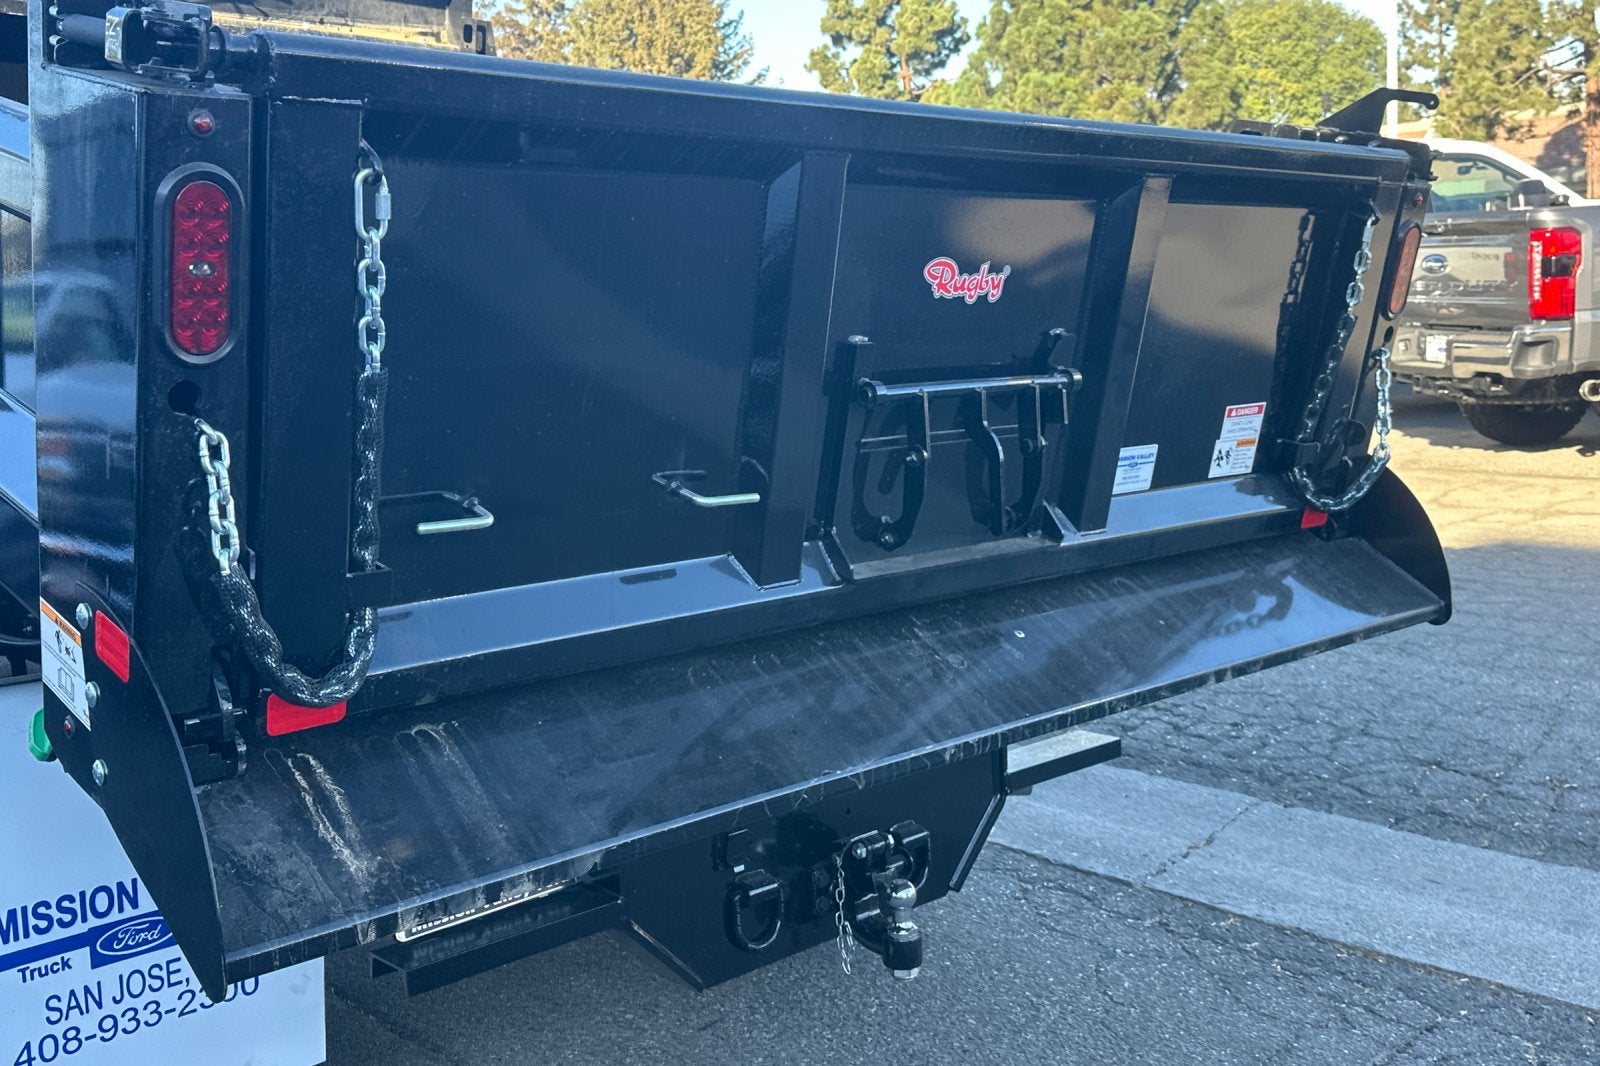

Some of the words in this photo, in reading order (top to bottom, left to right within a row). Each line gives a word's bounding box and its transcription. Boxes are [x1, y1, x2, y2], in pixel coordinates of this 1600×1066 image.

[924, 257, 1004, 304] Rugby
[1237, 406, 1259, 416] DANGER
[0, 878, 139, 945] MISSION
[113, 922, 162, 950] Ford
[17, 956, 73, 984] Truck
[45, 980, 103, 1026] SAN
[111, 957, 191, 1005] JOSE,
